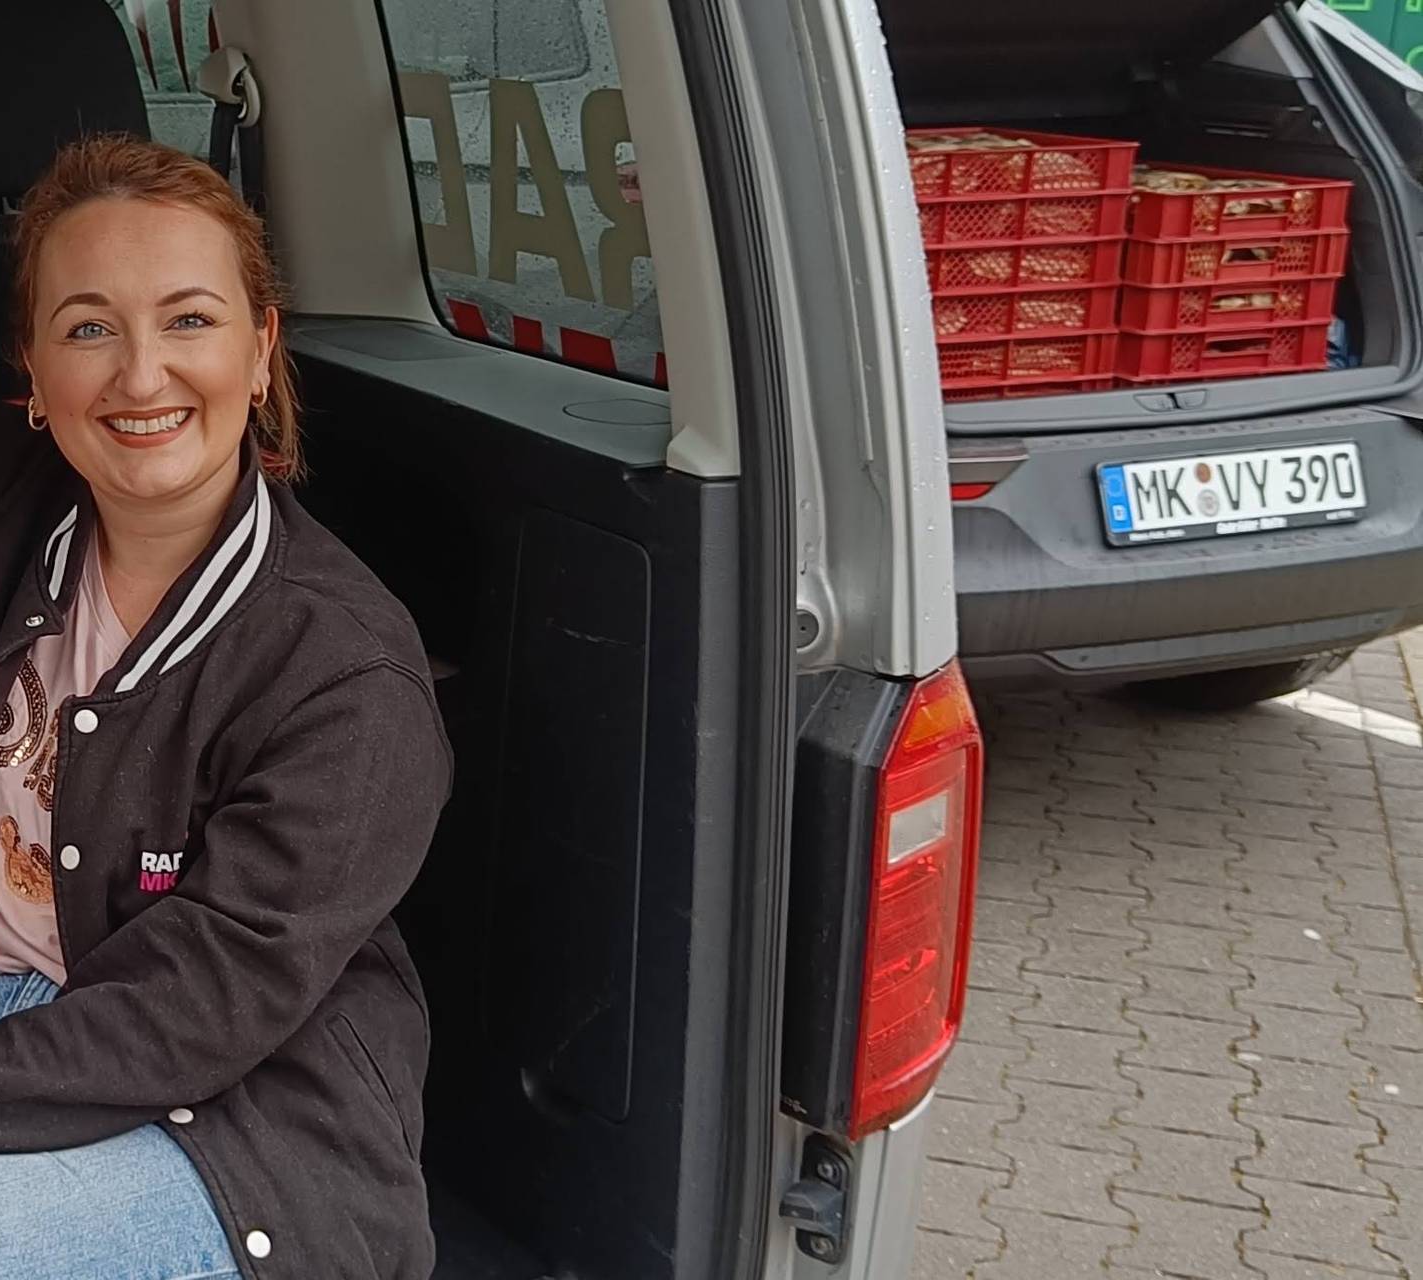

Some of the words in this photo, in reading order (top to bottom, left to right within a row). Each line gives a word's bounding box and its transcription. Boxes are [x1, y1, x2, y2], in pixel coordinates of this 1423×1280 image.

[1131, 466, 1193, 521] MK
[1216, 459, 1269, 511] VY
[1281, 452, 1357, 504] 390
